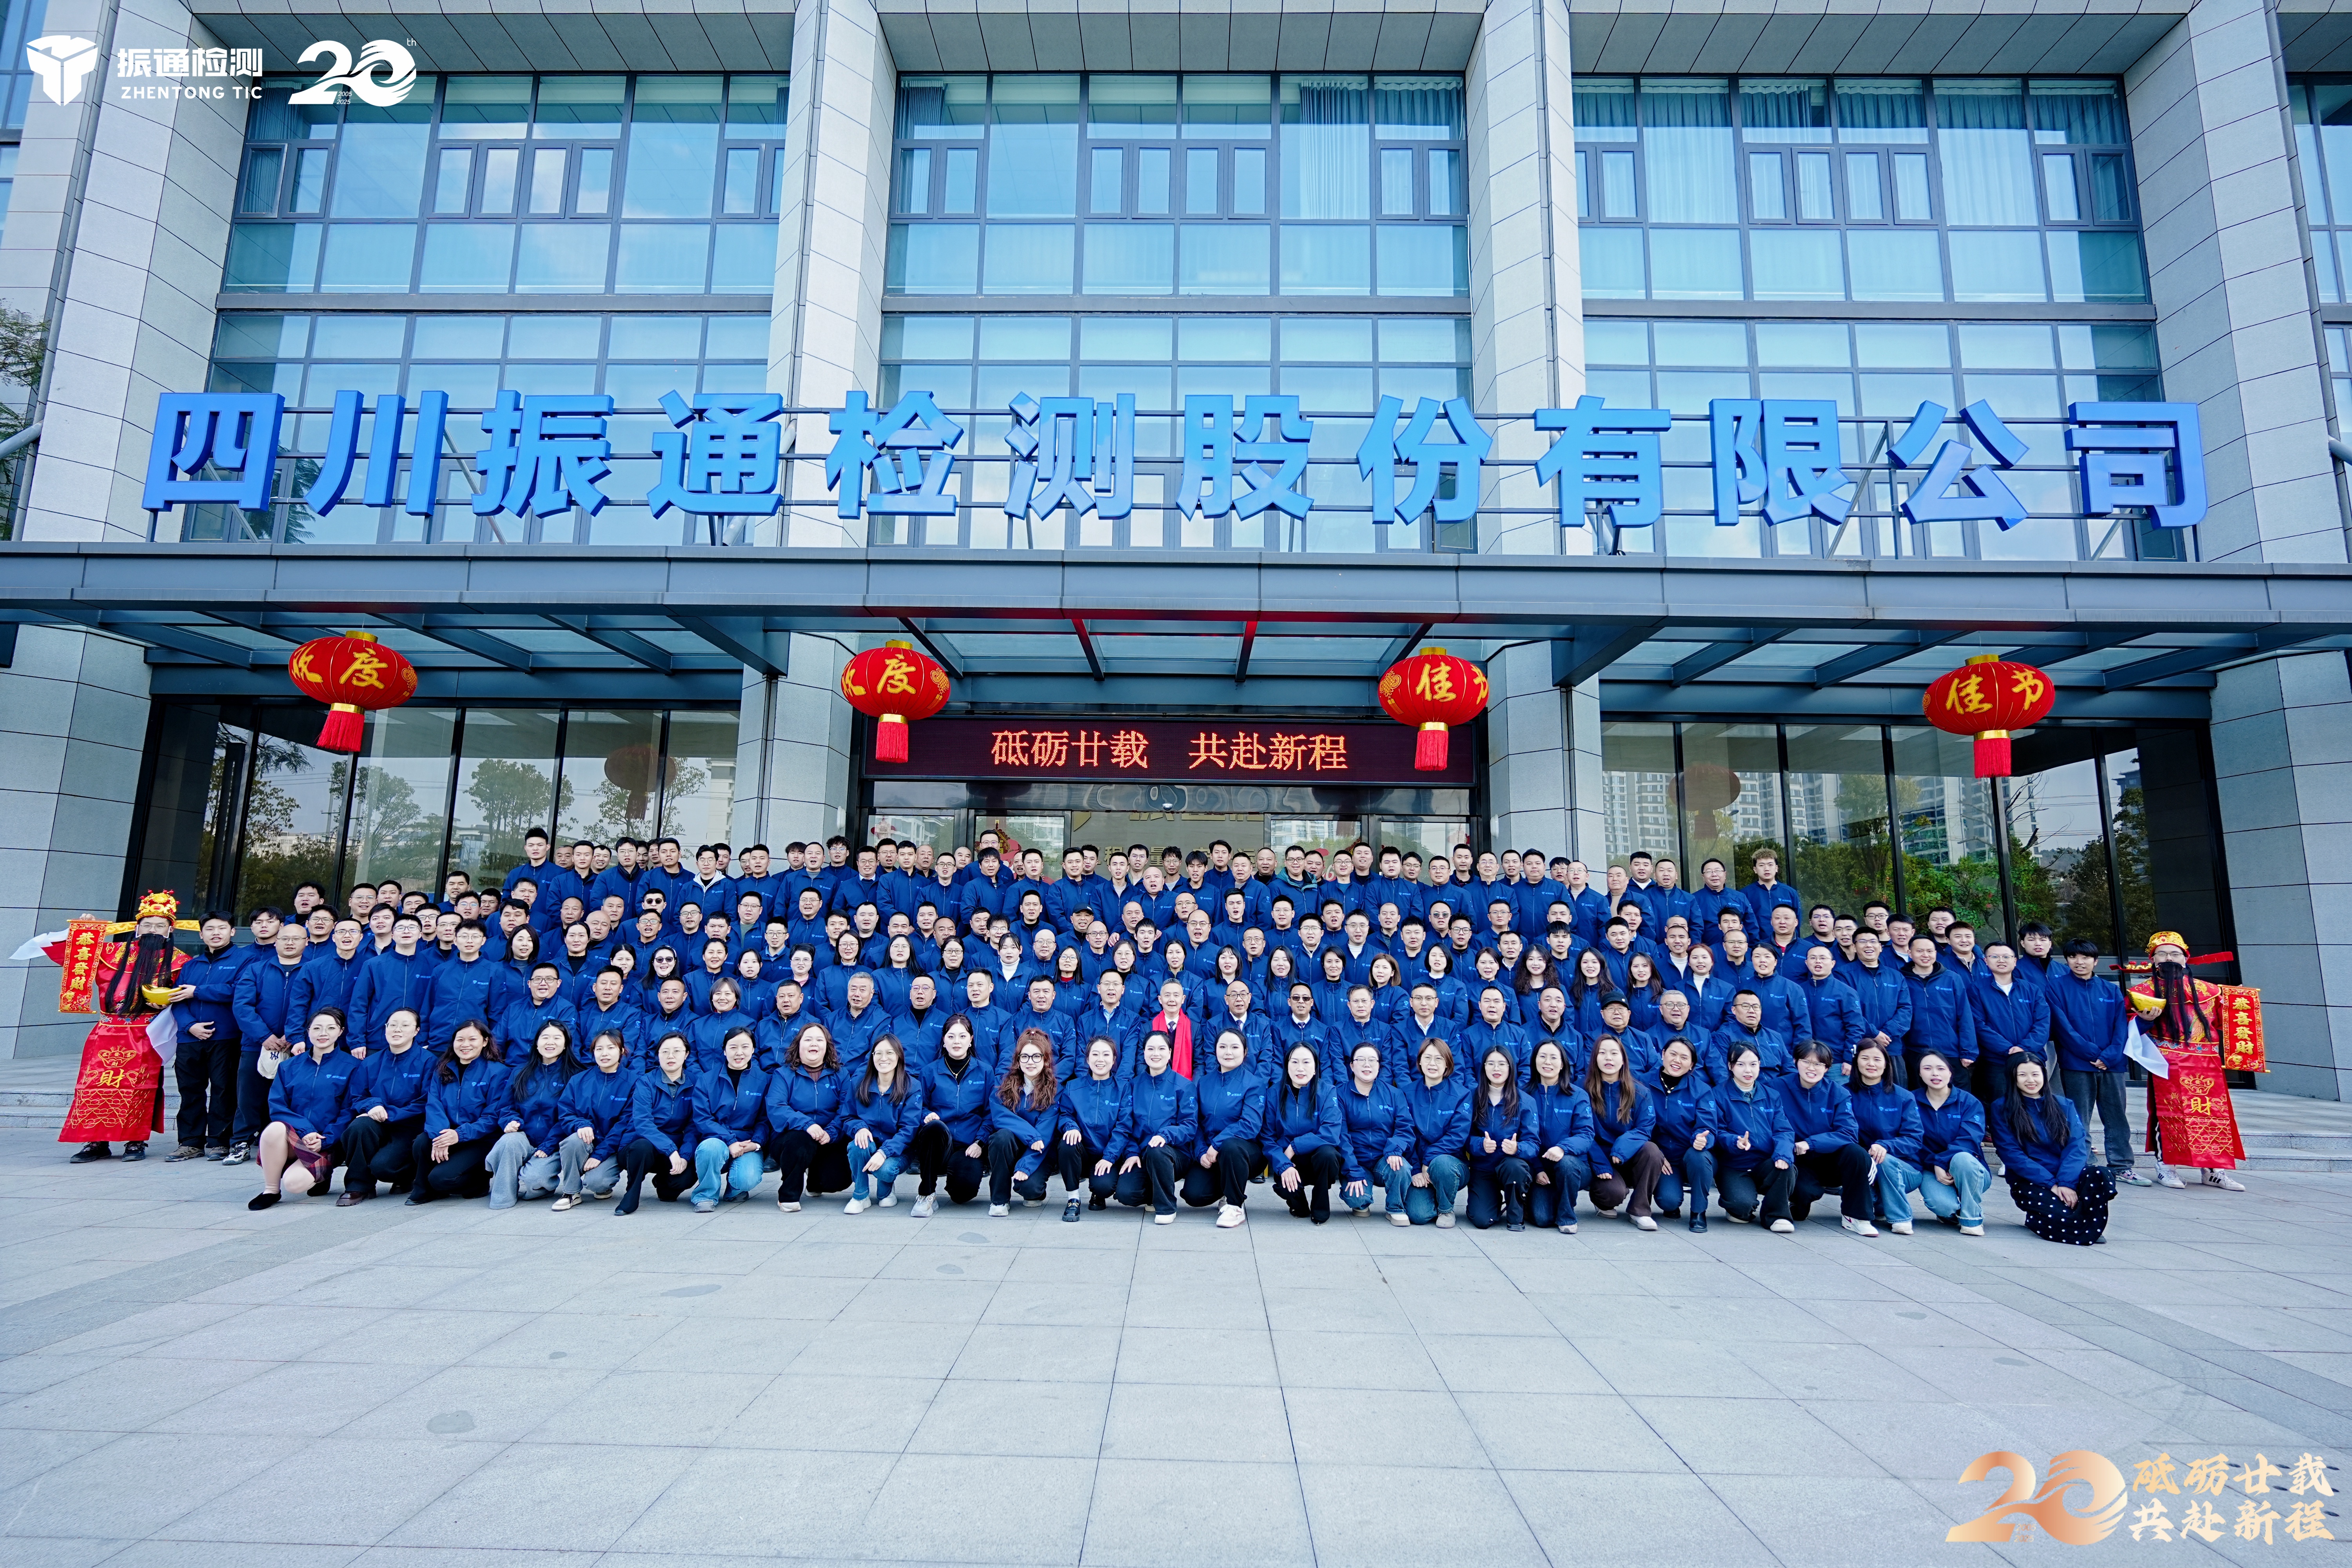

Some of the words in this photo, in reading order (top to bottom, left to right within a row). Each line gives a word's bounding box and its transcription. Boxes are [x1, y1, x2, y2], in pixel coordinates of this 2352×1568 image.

[142, 390, 2207, 531] 四川振通检测股份有限公司
[1945, 668, 2044, 715] 佳节
[991, 730, 1149, 769] 砥砺廿载
[1188, 731, 1348, 771] 共赴新程
[69, 931, 95, 991] 恭喜發財
[2232, 997, 2254, 1055] 恭喜發財
[96, 1068, 125, 1088] 財
[2189, 1096, 2212, 1116] 財
